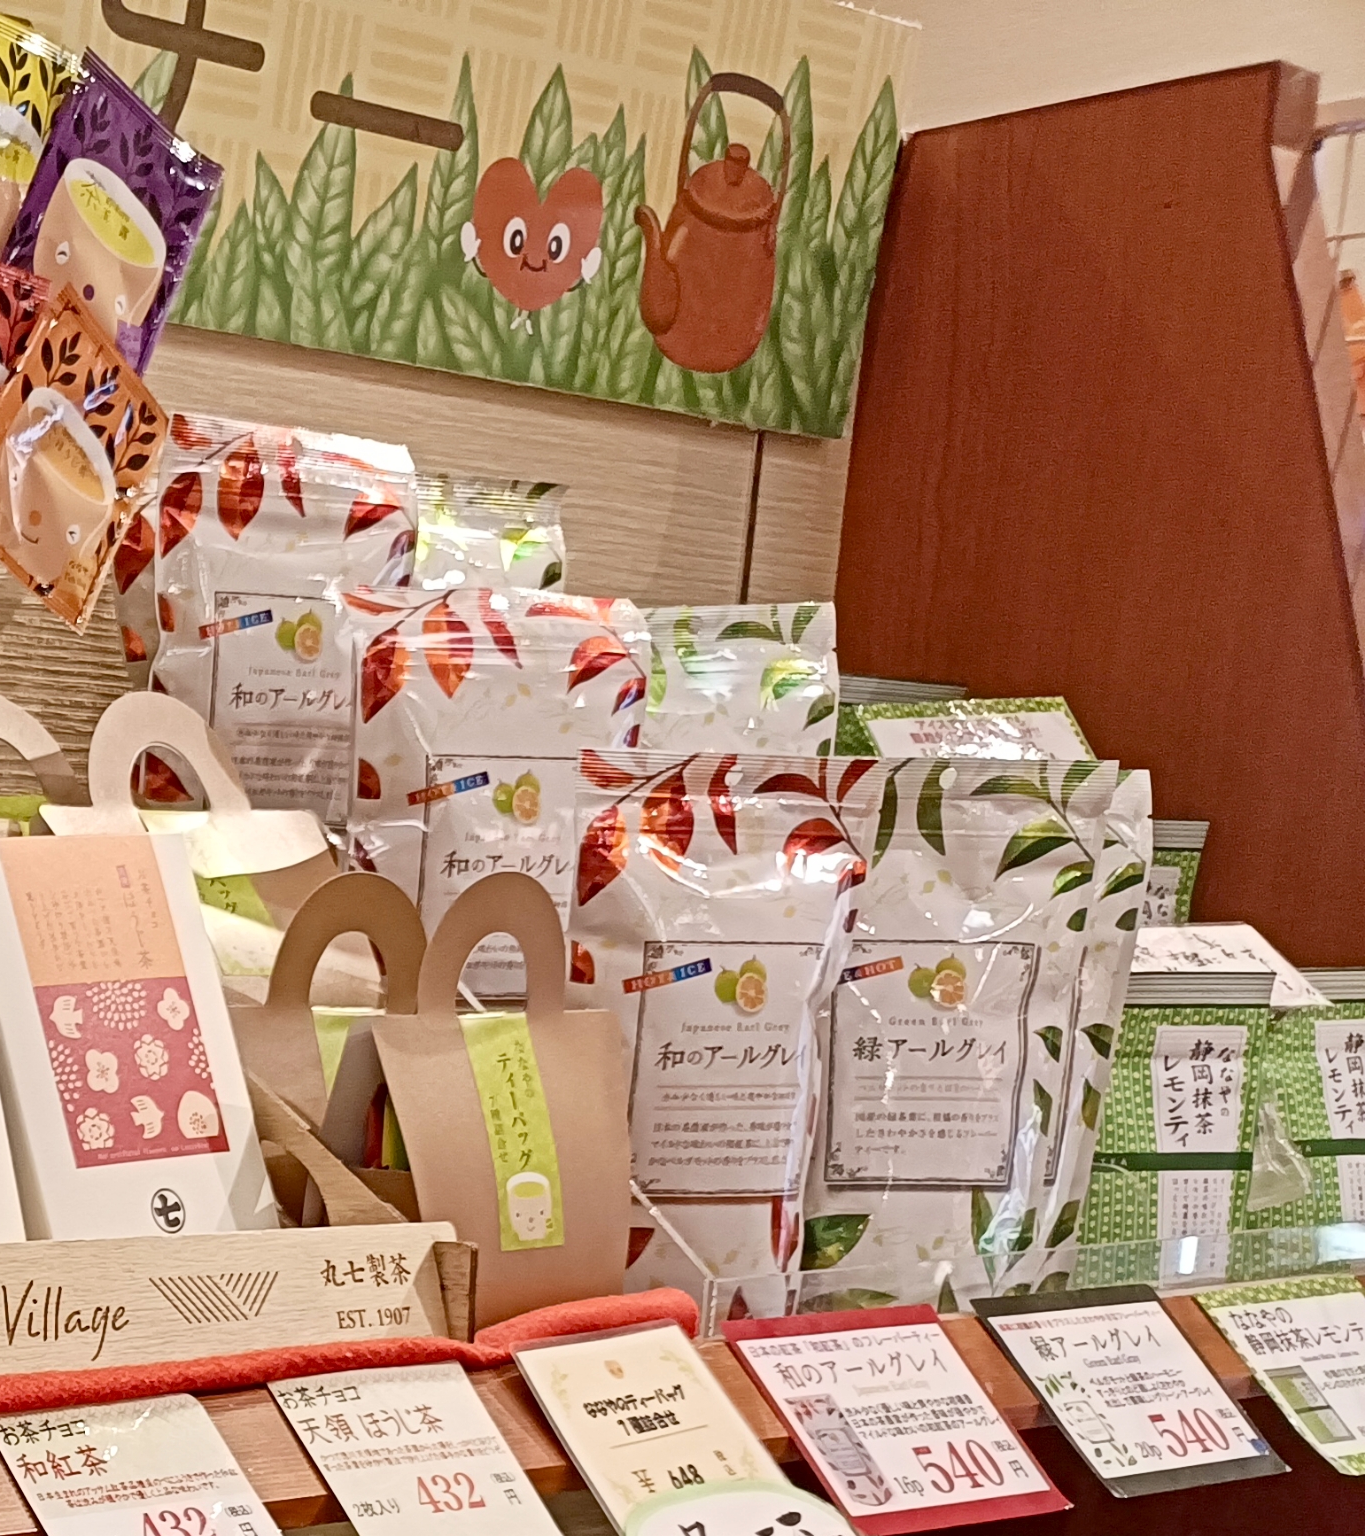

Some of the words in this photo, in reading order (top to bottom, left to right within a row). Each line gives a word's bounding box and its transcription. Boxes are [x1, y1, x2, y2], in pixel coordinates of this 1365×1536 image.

[1163, 1054, 1189, 1147] レモンティ
[1189, 1038, 1215, 1135] 静岡抹茶
[1216, 1046, 1239, 1117] ななやの
[1325, 1048, 1355, 1135] レモンティ
[319, 1253, 412, 1288] 丸七製茶
[0, 1280, 130, 1362] Village
[337, 1309, 373, 1329] EST.
[377, 1306, 411, 1327] 1907
[1228, 1306, 1294, 1331] ななやの
[1029, 1324, 1162, 1362] 緑アールグレイ
[773, 1348, 949, 1390] 和のアールグレイ
[277, 1385, 361, 1410] お茶チョコ
[0, 1419, 86, 1447] お茶チョコ
[297, 1414, 360, 1445] 天領
[357, 1403, 445, 1439] ほうじ茶
[1148, 1407, 1230, 1458] 540
[16, 1444, 108, 1484] 和紅茶
[667, 1463, 705, 1490] 648
[894, 1475, 925, 1497] 16p
[912, 1439, 1005, 1494] 540
[1007, 1459, 1030, 1479] 円
[352, 1498, 401, 1517] 2枚入り
[417, 1472, 486, 1514] 432
[503, 1488, 523, 1505] 円
